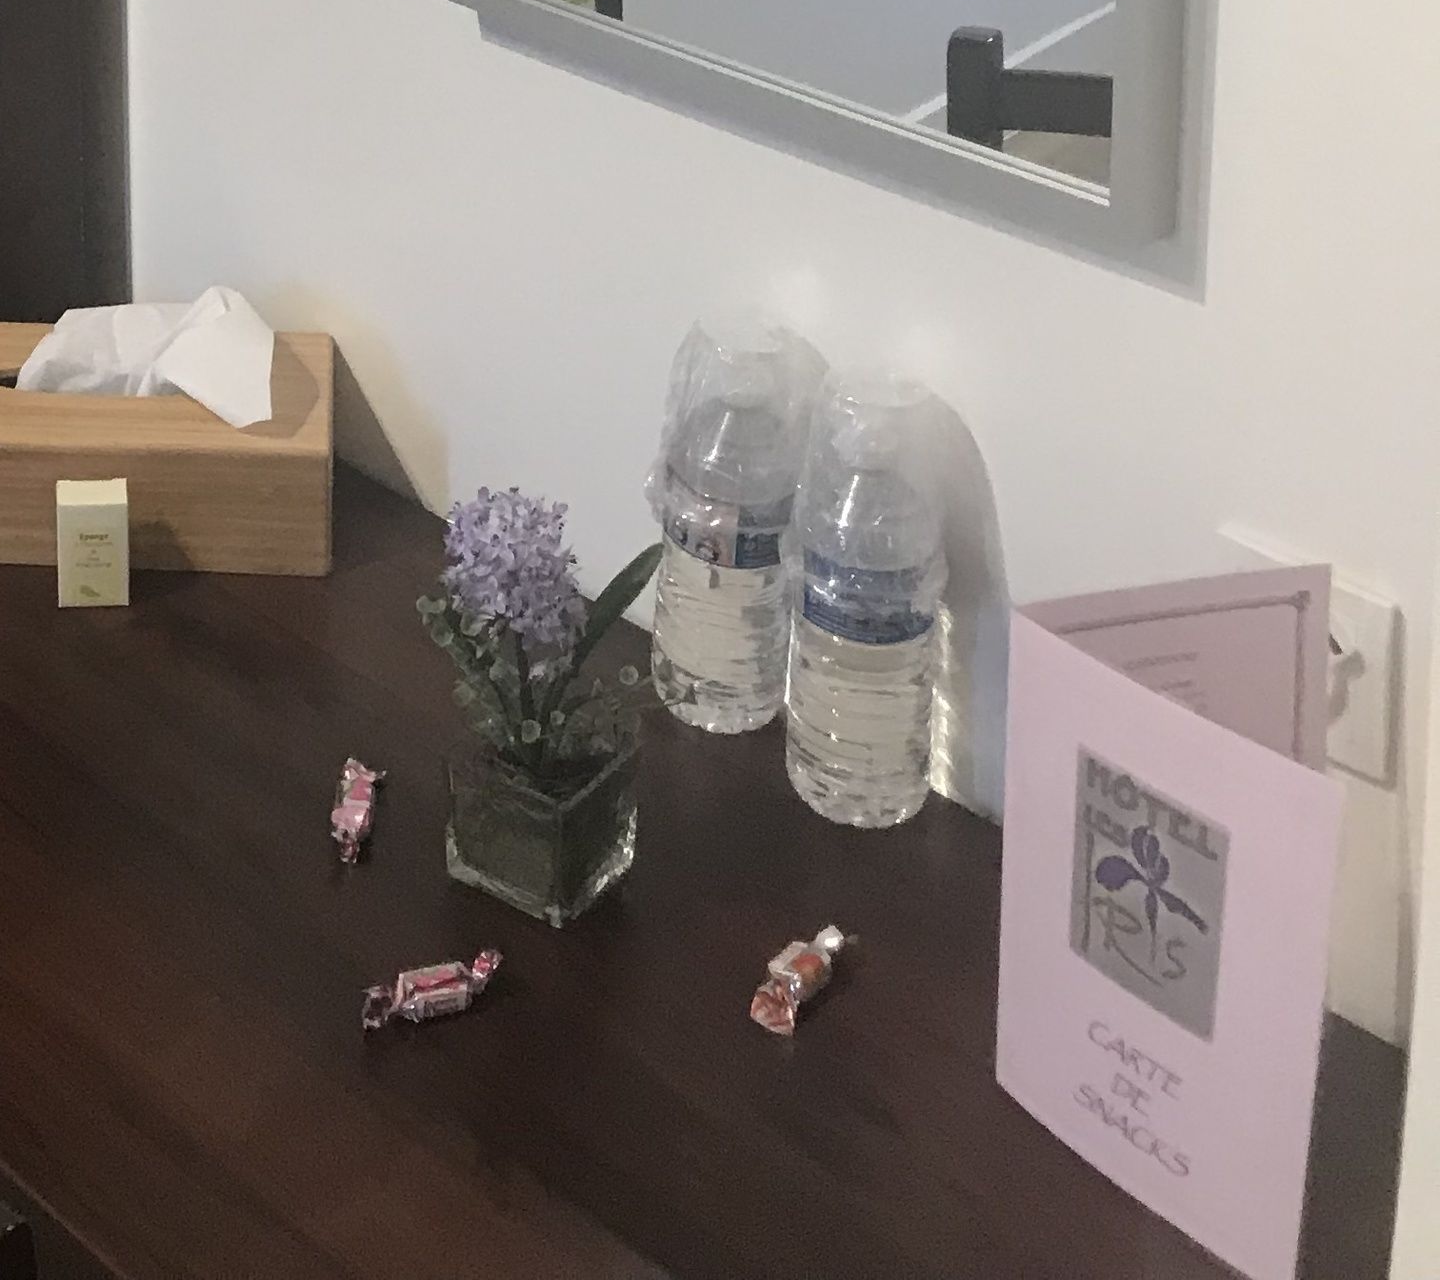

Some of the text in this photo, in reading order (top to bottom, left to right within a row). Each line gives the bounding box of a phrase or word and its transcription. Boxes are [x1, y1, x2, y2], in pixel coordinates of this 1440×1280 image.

[1088, 1020, 1184, 1099] CARTE
[1111, 1073, 1151, 1117] DE
[1073, 1083, 1191, 1176] SNACKS
